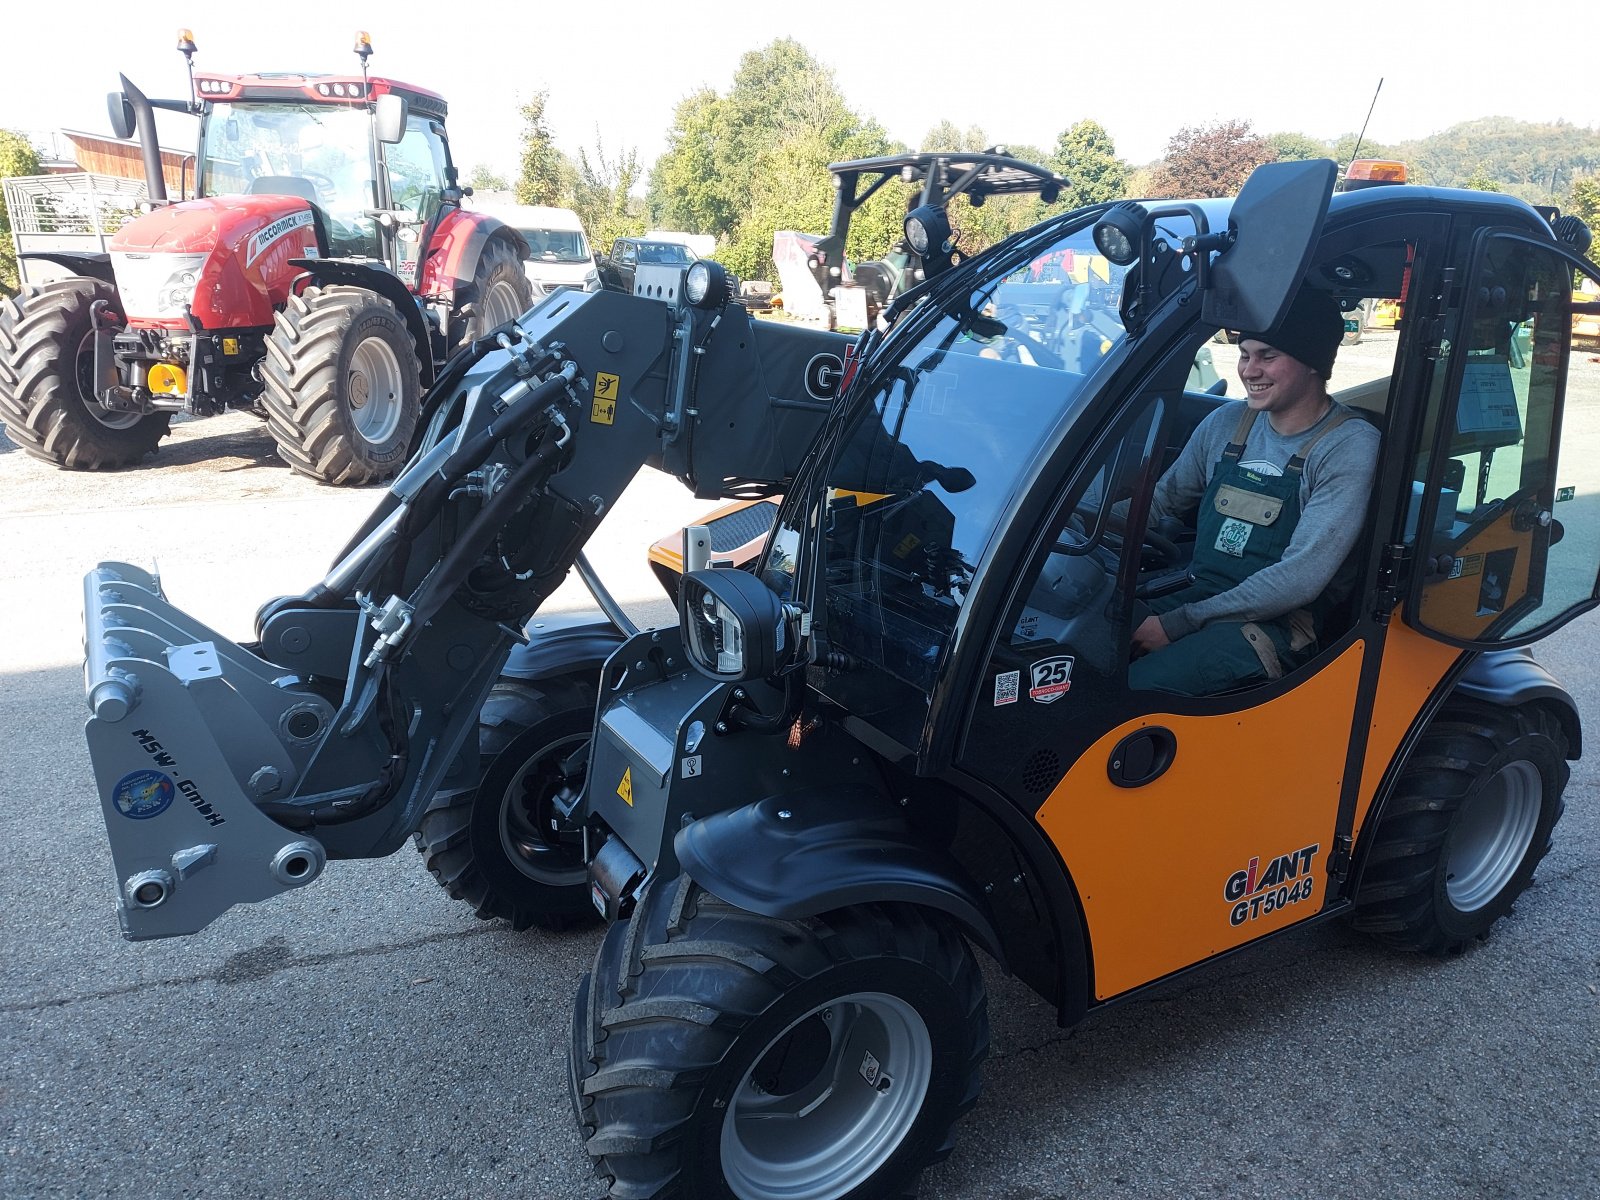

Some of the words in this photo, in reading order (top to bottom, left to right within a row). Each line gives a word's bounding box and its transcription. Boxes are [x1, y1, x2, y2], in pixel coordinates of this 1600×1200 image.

[1037, 663, 1067, 687] 25
[131, 728, 176, 768] MSW
[176, 779, 226, 828] GmbH
[1229, 876, 1314, 927] GT5048
